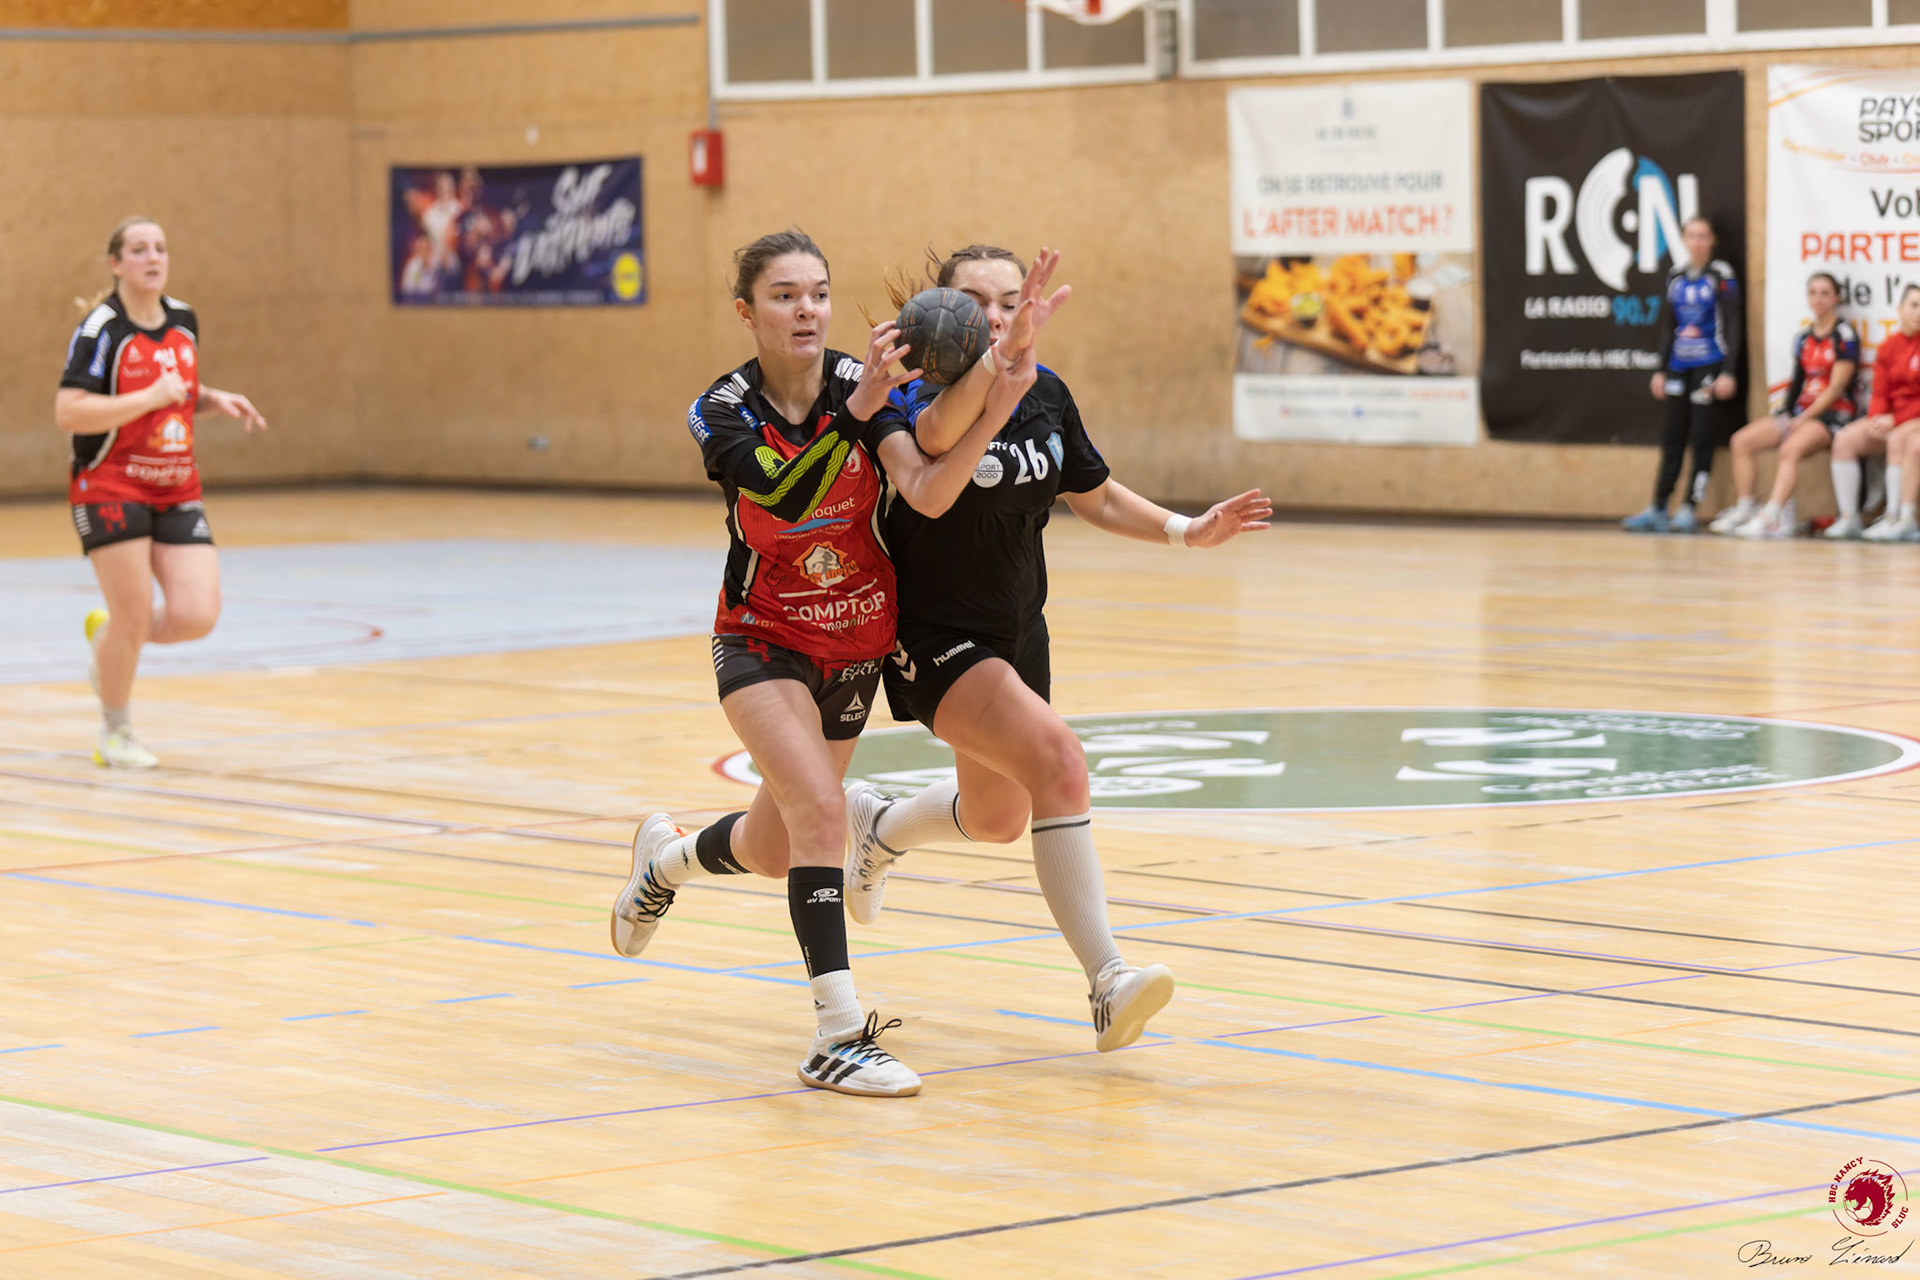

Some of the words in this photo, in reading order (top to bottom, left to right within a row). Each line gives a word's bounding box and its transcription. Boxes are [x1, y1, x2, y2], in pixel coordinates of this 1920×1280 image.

[1859, 121, 1920, 142] SPO
[1860, 152, 1888, 165] Club
[1259, 175, 1281, 195] ON
[1284, 174, 1303, 194] SE
[1308, 172, 1390, 194] RETROUVE
[1394, 170, 1443, 191] POUR
[1243, 207, 1338, 239] L'AFTER
[1345, 205, 1438, 236] MATCH
[1840, 275, 1872, 306] de
[1524, 297, 1546, 319] LA
[1548, 296, 1611, 318] RADIO
[1612, 295, 1660, 326] 90.7
[1520, 349, 1586, 370] Partenaire
[1586, 349, 1602, 370] du
[1603, 349, 1631, 370] HBC
[1009, 438, 1049, 486] 26
[976, 472, 998, 480] 2000
[932, 640, 976, 667] hummel
[840, 710, 866, 722] SELECT
